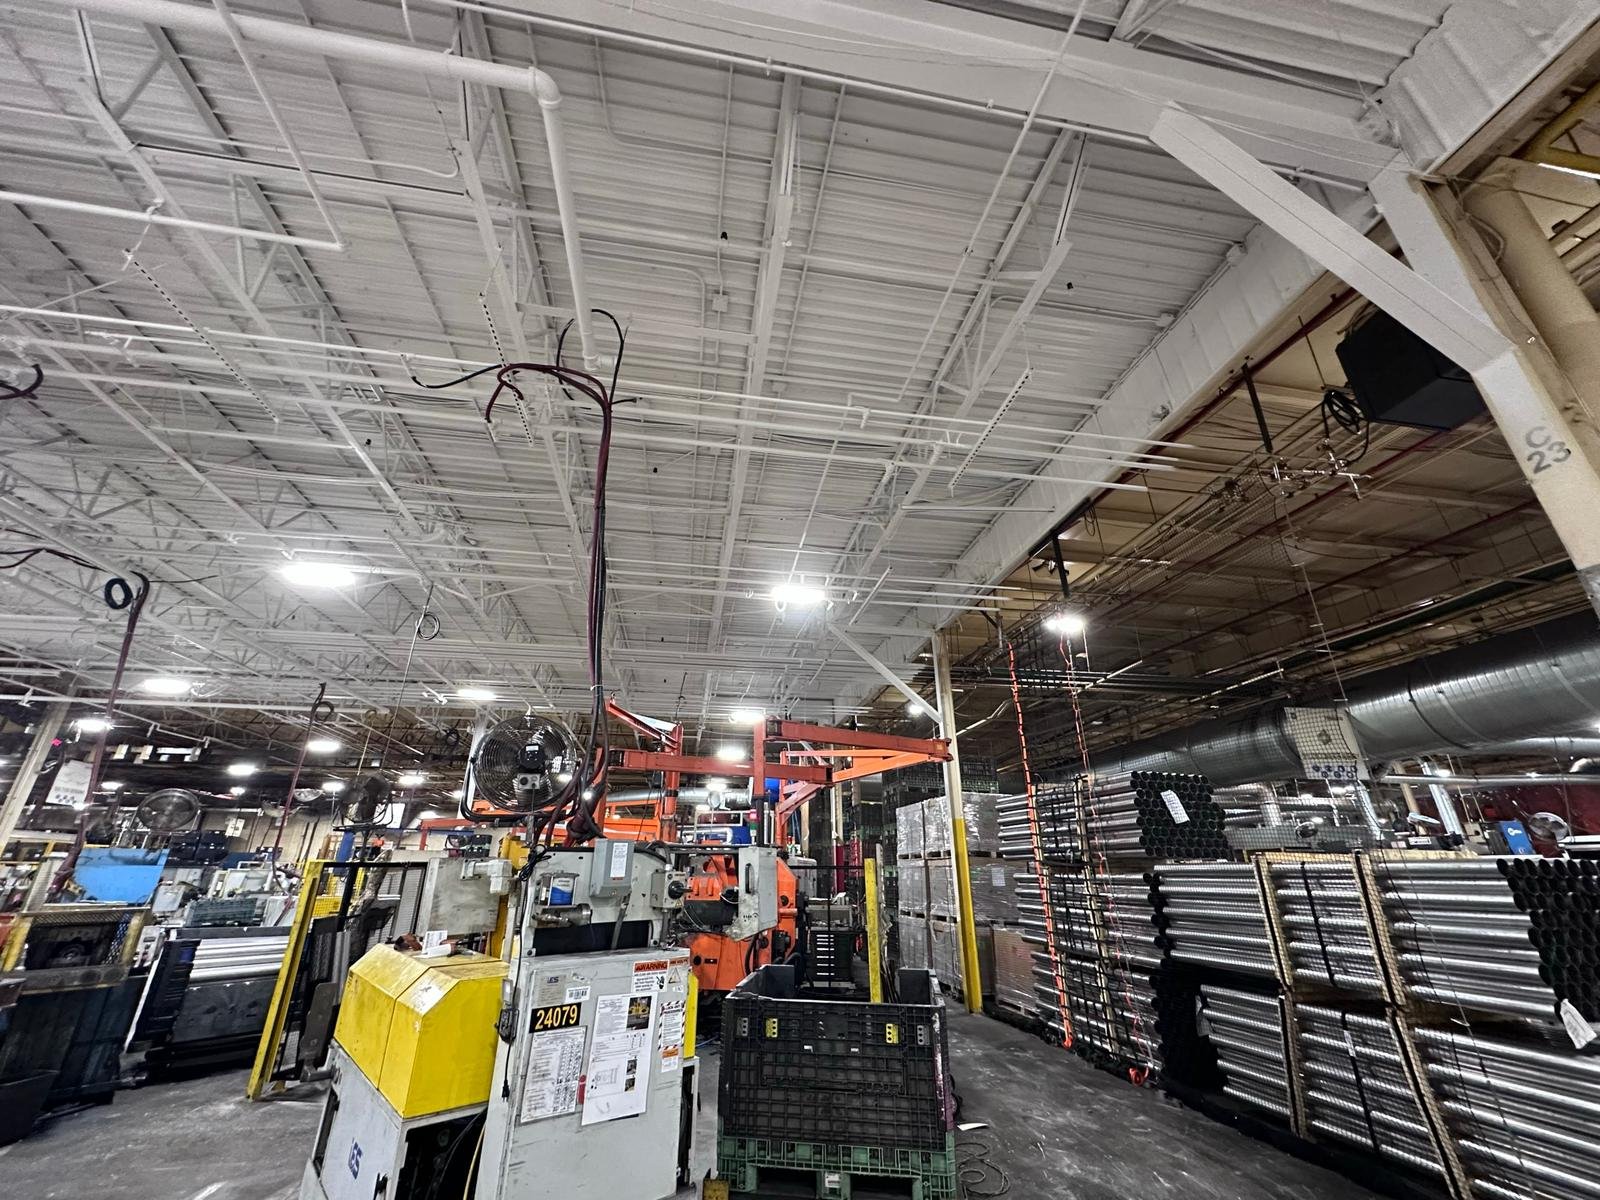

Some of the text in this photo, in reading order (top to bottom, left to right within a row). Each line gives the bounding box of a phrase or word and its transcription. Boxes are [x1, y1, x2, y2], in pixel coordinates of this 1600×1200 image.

[1525, 426, 1552, 448] C
[1526, 441, 1571, 474] 23
[640, 962, 667, 971] WARNING
[535, 1005, 578, 1030] 24079
